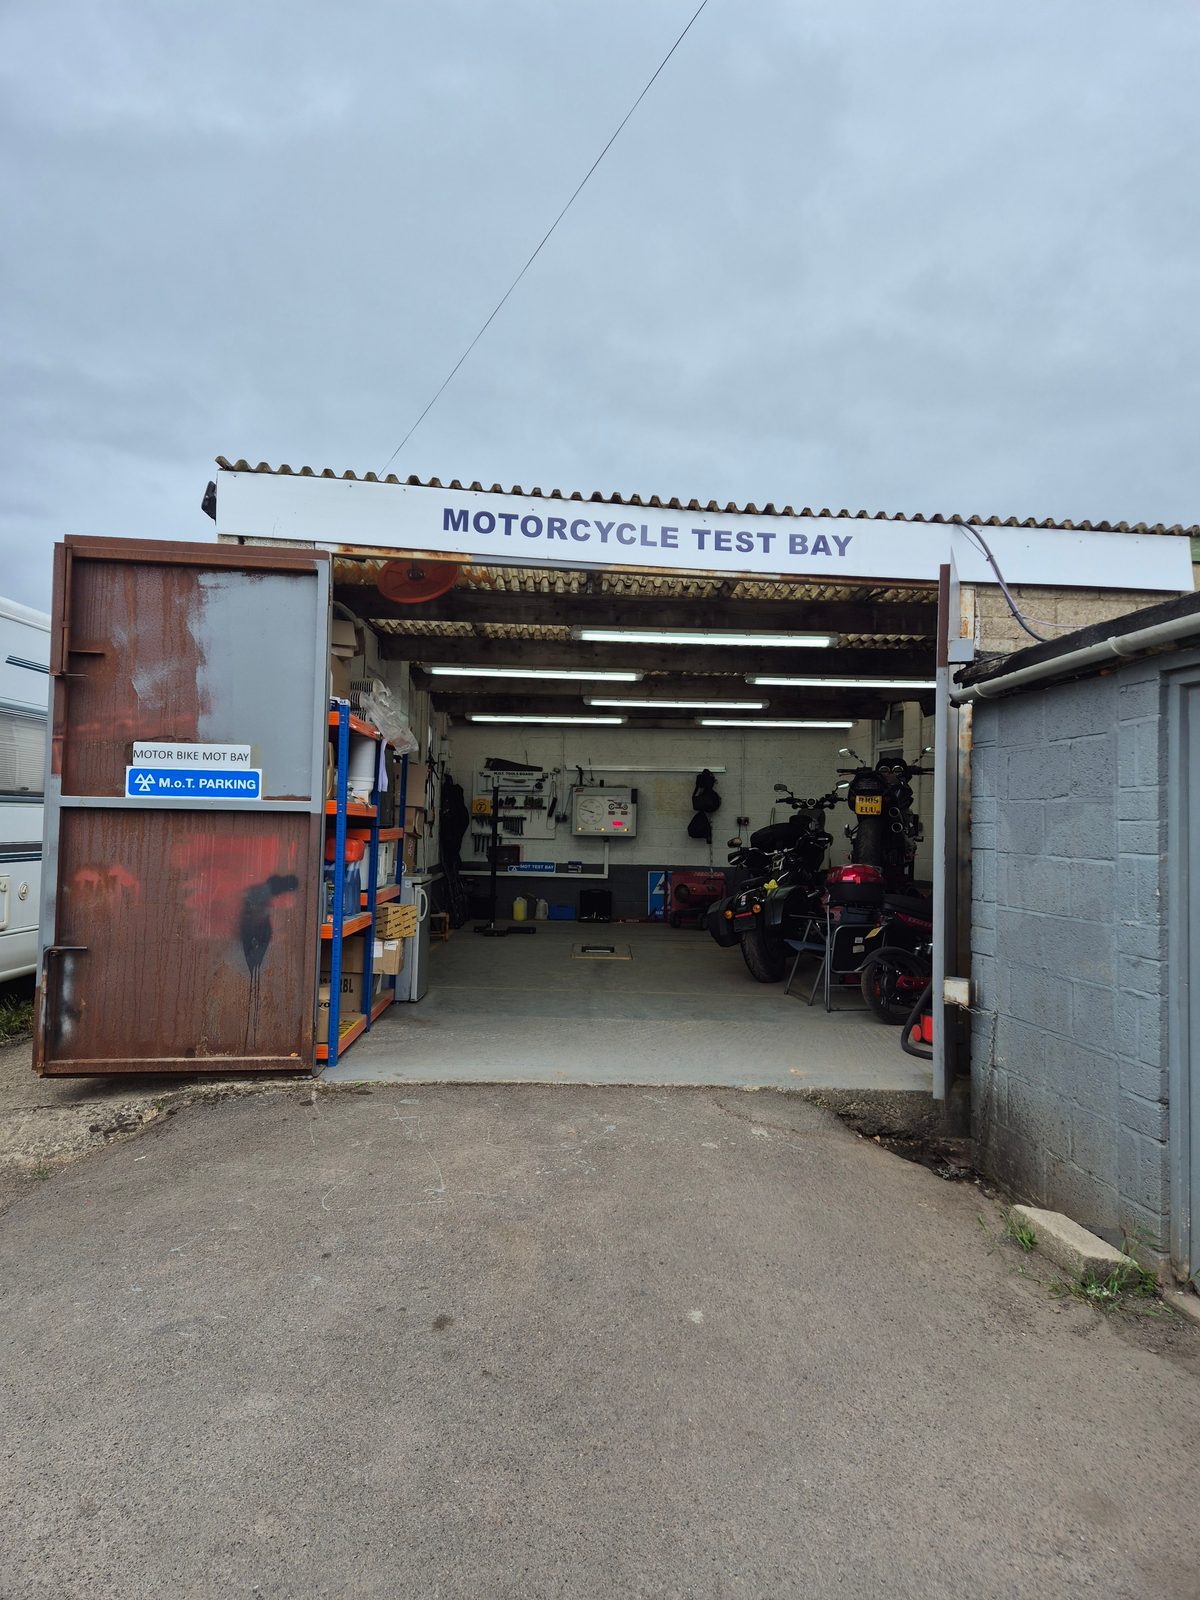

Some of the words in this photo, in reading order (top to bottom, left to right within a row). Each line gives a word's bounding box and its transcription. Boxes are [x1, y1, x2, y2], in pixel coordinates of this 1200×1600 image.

[442, 507, 679, 549] MOTORCYCLE
[692, 528, 776, 553] TEST
[789, 532, 853, 557] BAY
[133, 749, 173, 760] MOTOR
[176, 750, 199, 761] BIKE
[202, 751, 227, 761] MOT
[230, 752, 249, 762] BAY
[158, 777, 195, 789] M.o.T.
[199, 778, 256, 790] PARKING
